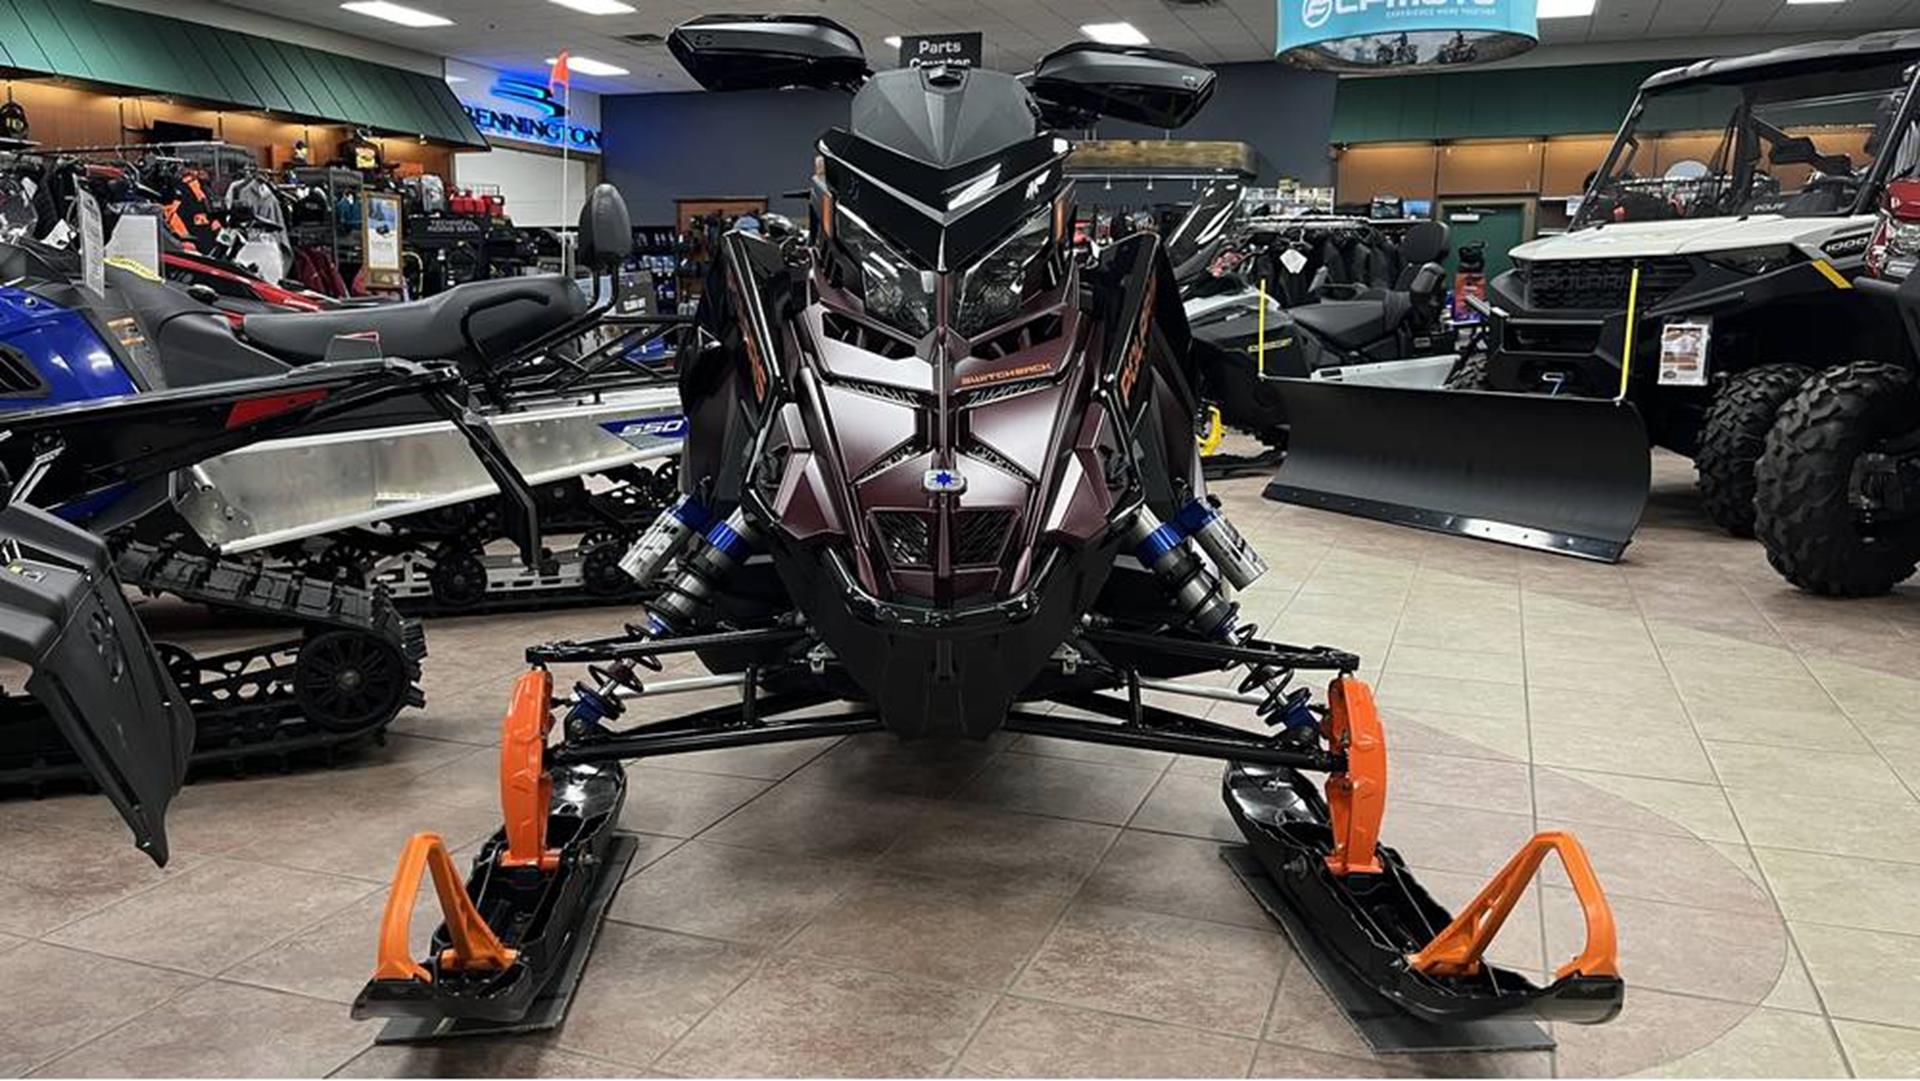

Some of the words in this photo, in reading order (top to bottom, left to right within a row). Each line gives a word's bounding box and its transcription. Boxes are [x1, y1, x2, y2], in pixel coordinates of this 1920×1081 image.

[919, 40, 961, 54] Parts
[1825, 237, 1869, 252] 1000
[961, 362, 1052, 386] SWITCHBACK
[620, 420, 684, 437] 550
